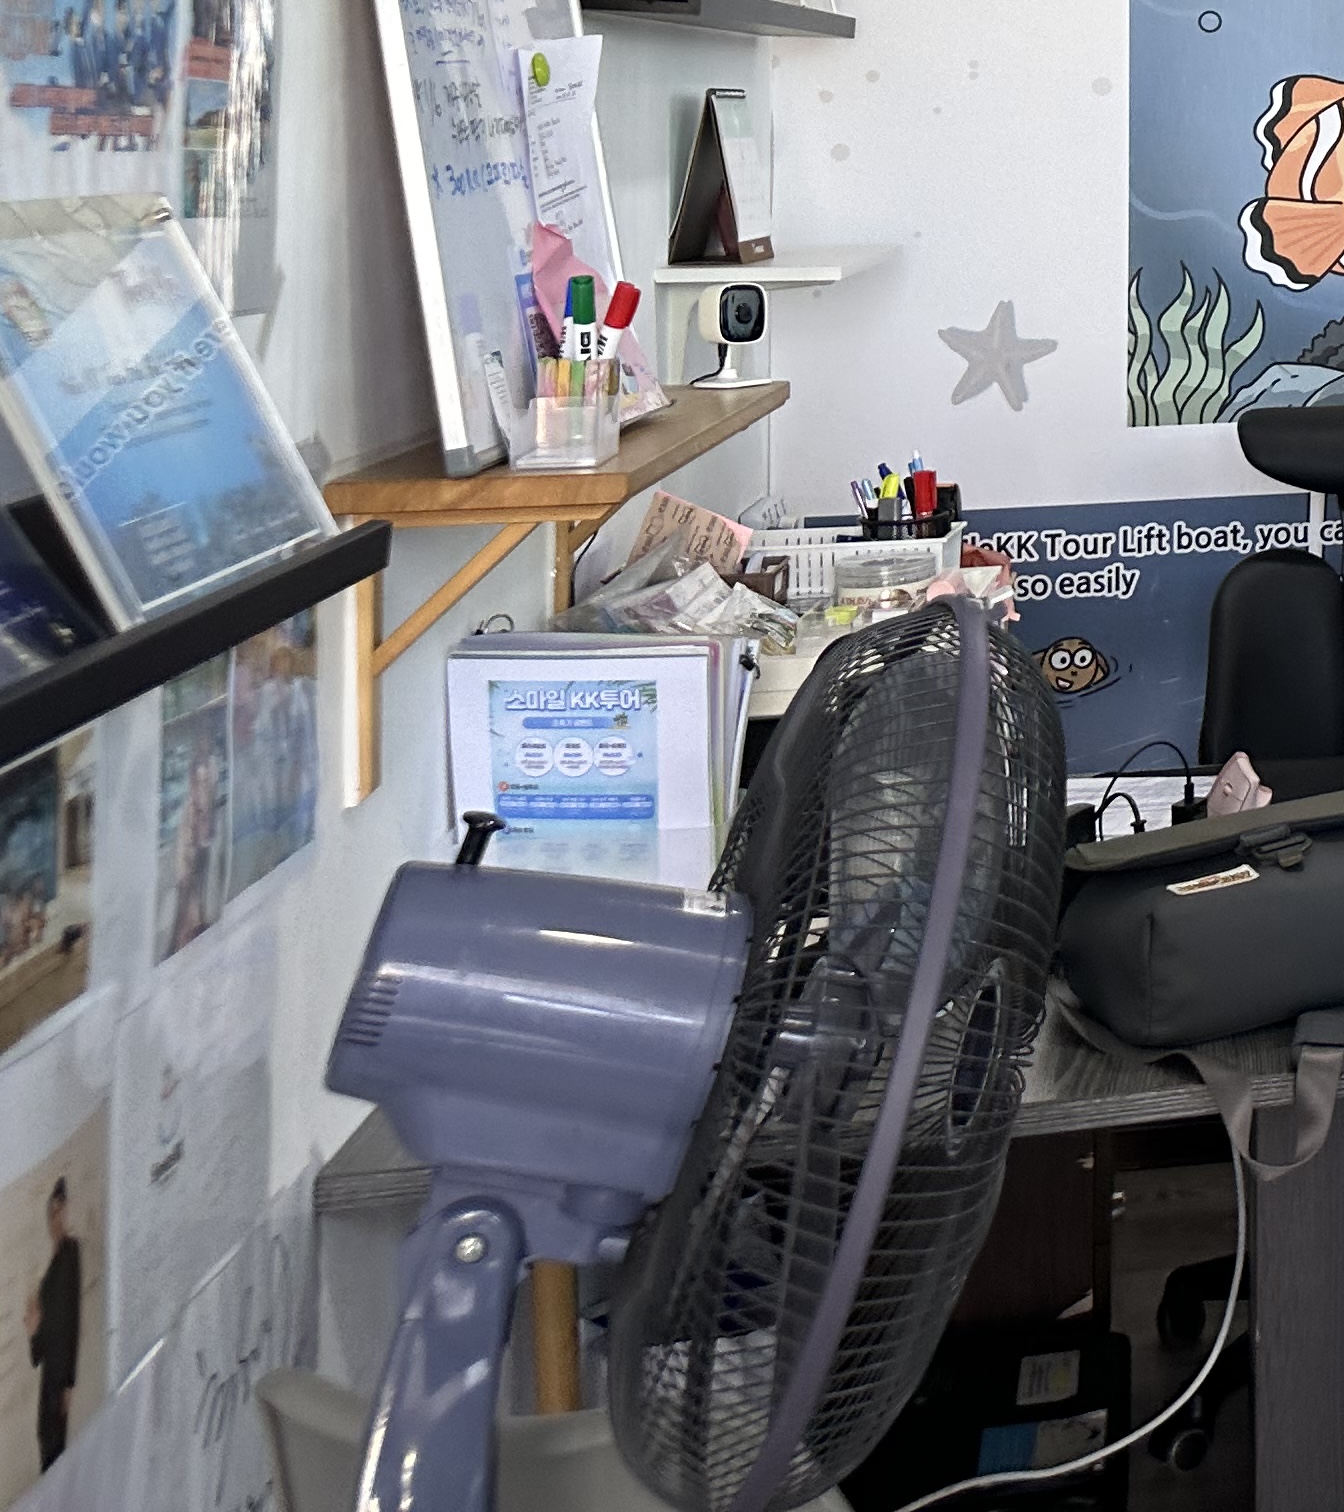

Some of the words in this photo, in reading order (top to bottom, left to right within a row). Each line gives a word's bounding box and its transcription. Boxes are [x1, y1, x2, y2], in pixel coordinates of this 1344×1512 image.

[1044, 533, 1112, 557] Tour
[1123, 526, 1167, 554] Lift
[1177, 524, 1249, 551] boat,
[1258, 525, 1309, 550] you
[1320, 522, 1343, 543] ca
[1017, 578, 1048, 598] so
[1059, 567, 1136, 596] easily
[506, 689, 567, 711] 스마일
[570, 689, 641, 711] KK투어
